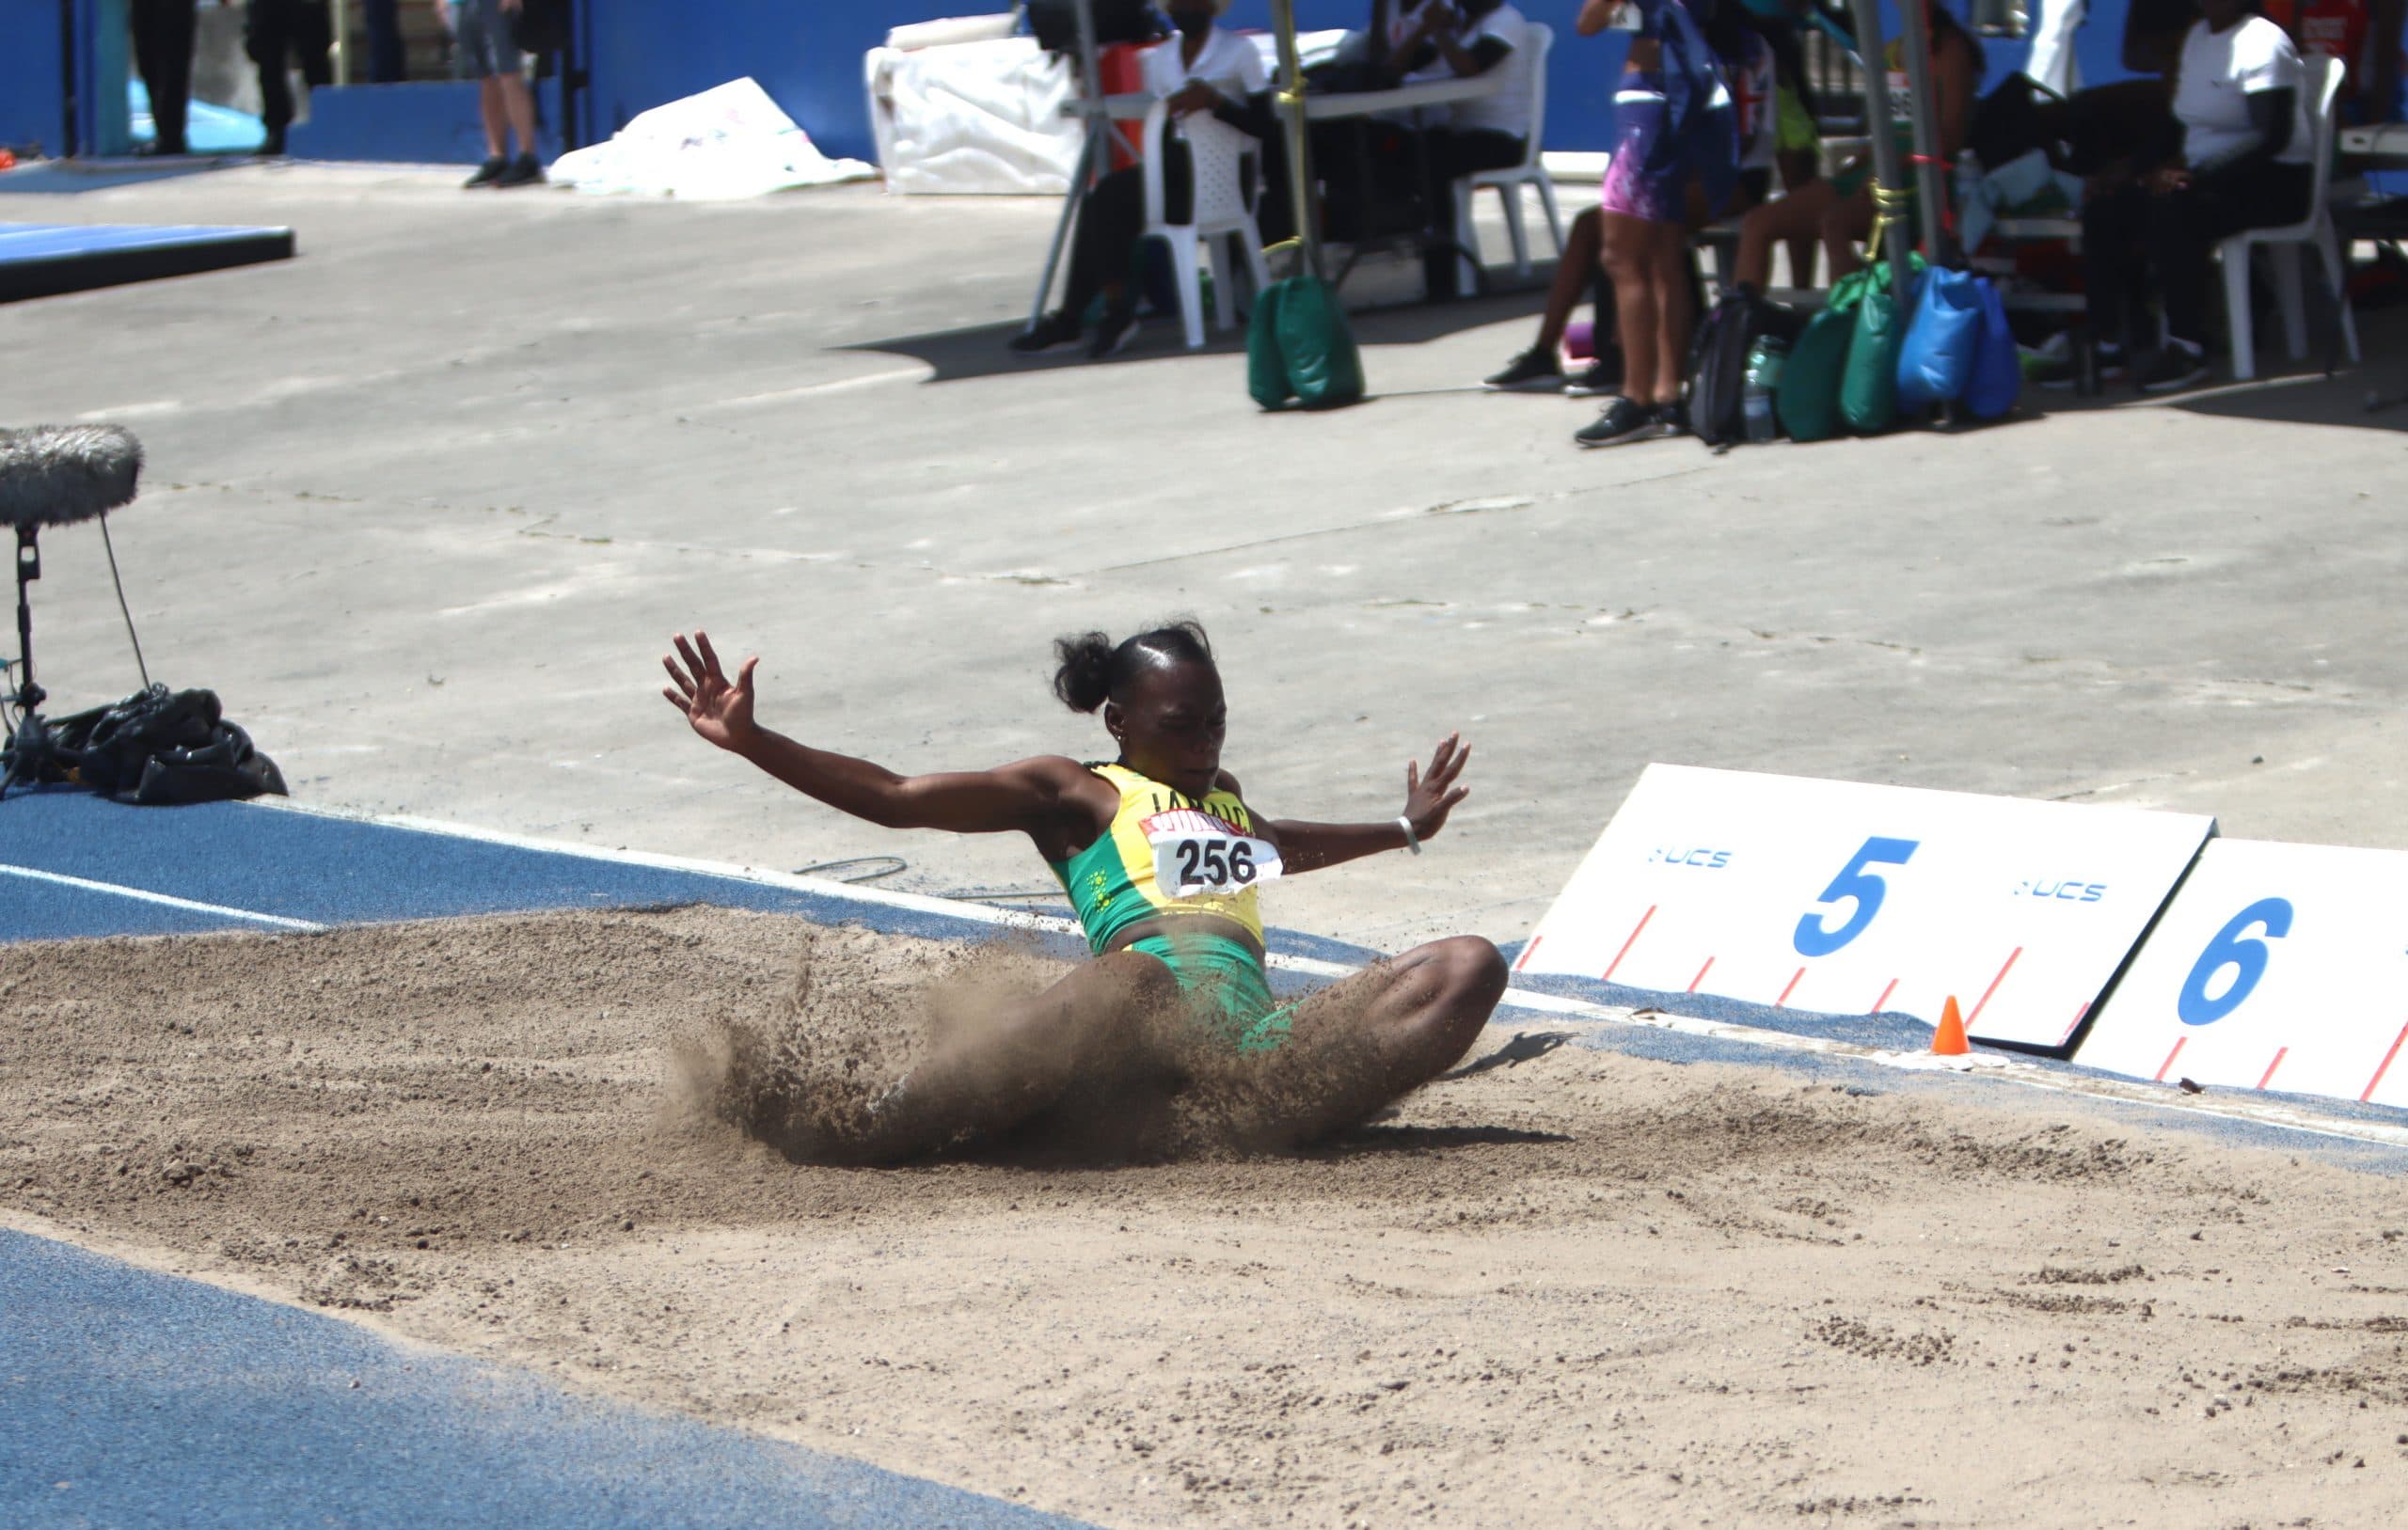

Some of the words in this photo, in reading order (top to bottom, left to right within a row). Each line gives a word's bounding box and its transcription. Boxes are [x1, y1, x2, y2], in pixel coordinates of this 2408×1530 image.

[1176, 839, 1257, 886] 256
[1665, 848, 1733, 868] UCS
[1793, 836, 1921, 957] 5
[2032, 880, 2108, 902] UCS
[2178, 897, 2294, 1026] 6
